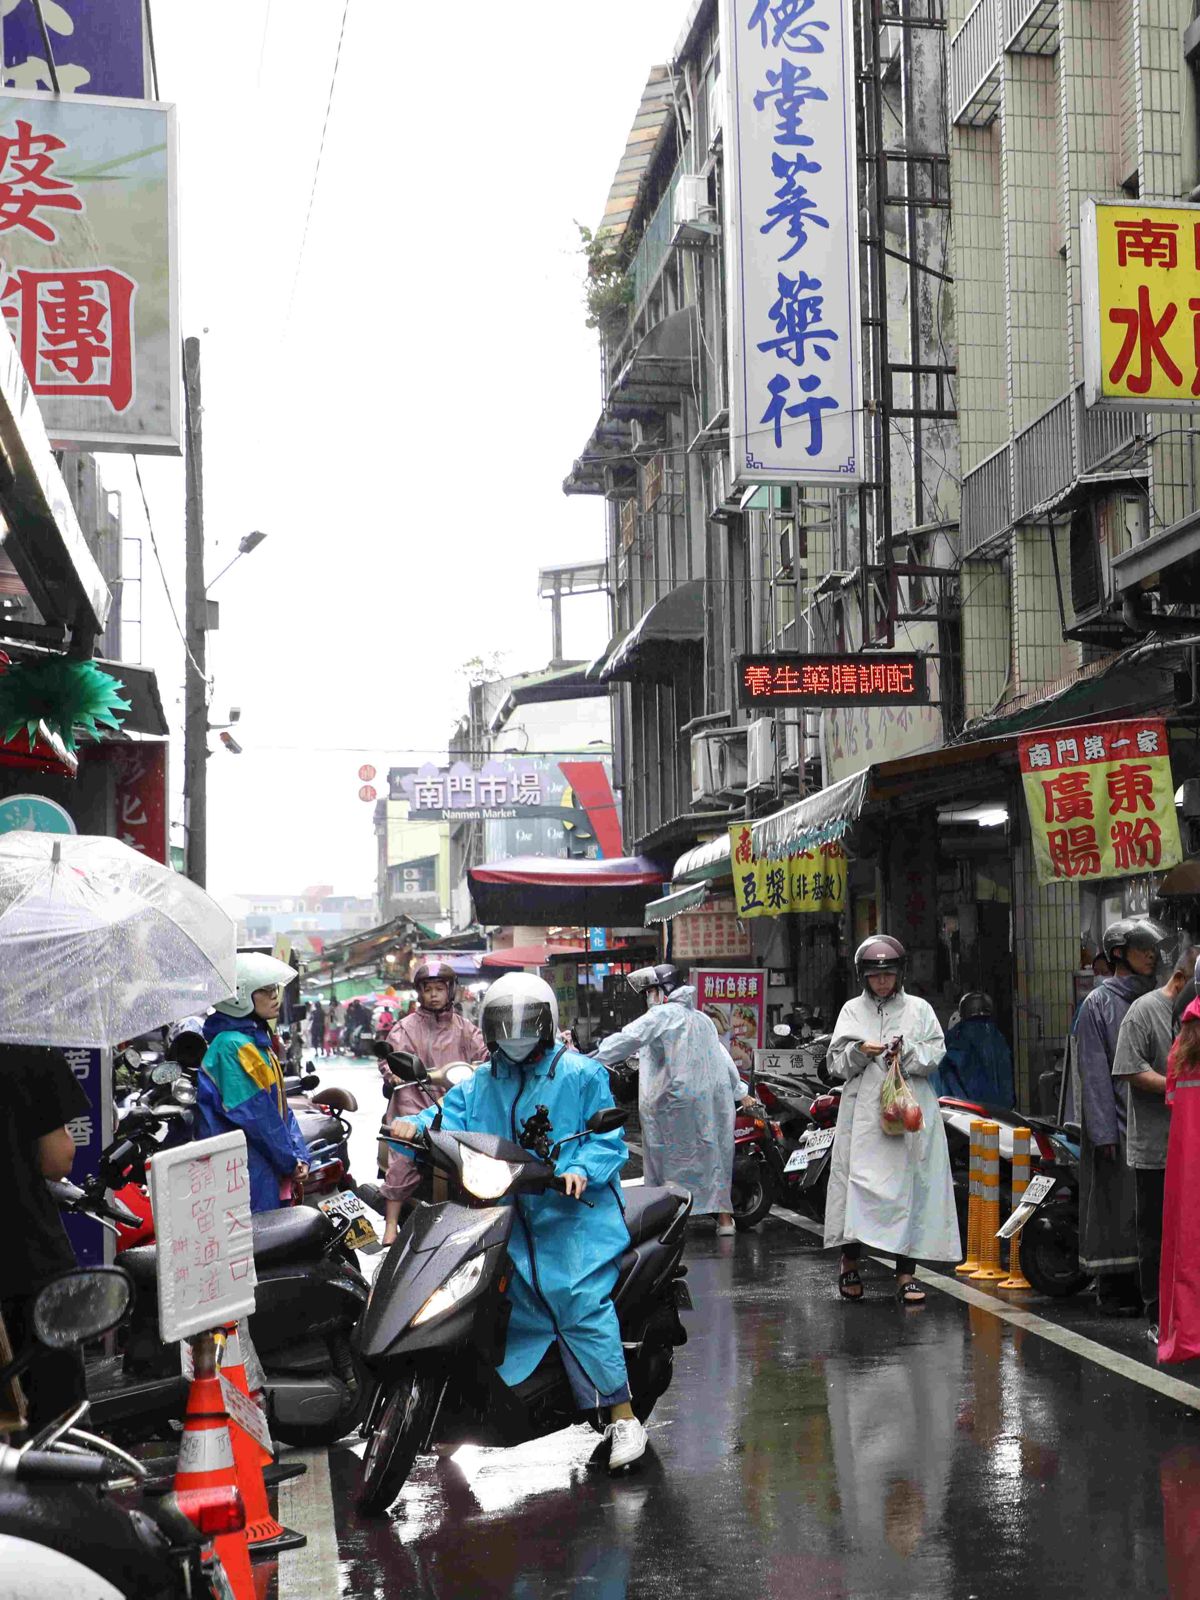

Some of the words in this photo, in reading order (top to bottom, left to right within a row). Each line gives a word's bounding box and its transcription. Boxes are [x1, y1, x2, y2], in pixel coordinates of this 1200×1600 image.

[745, 664, 915, 696] 養生藥膳調配
[1029, 731, 1159, 767] 南門第一家
[414, 773, 541, 809] 南門市場
[1041, 764, 1155, 824] 廣東
[442, 809, 480, 819] Nanmen
[482, 808, 516, 818] Market
[1046, 820, 1162, 878] 腸粉
[704, 976, 758, 999] 粉紅色餐車
[225, 1157, 251, 1281] 出入口
